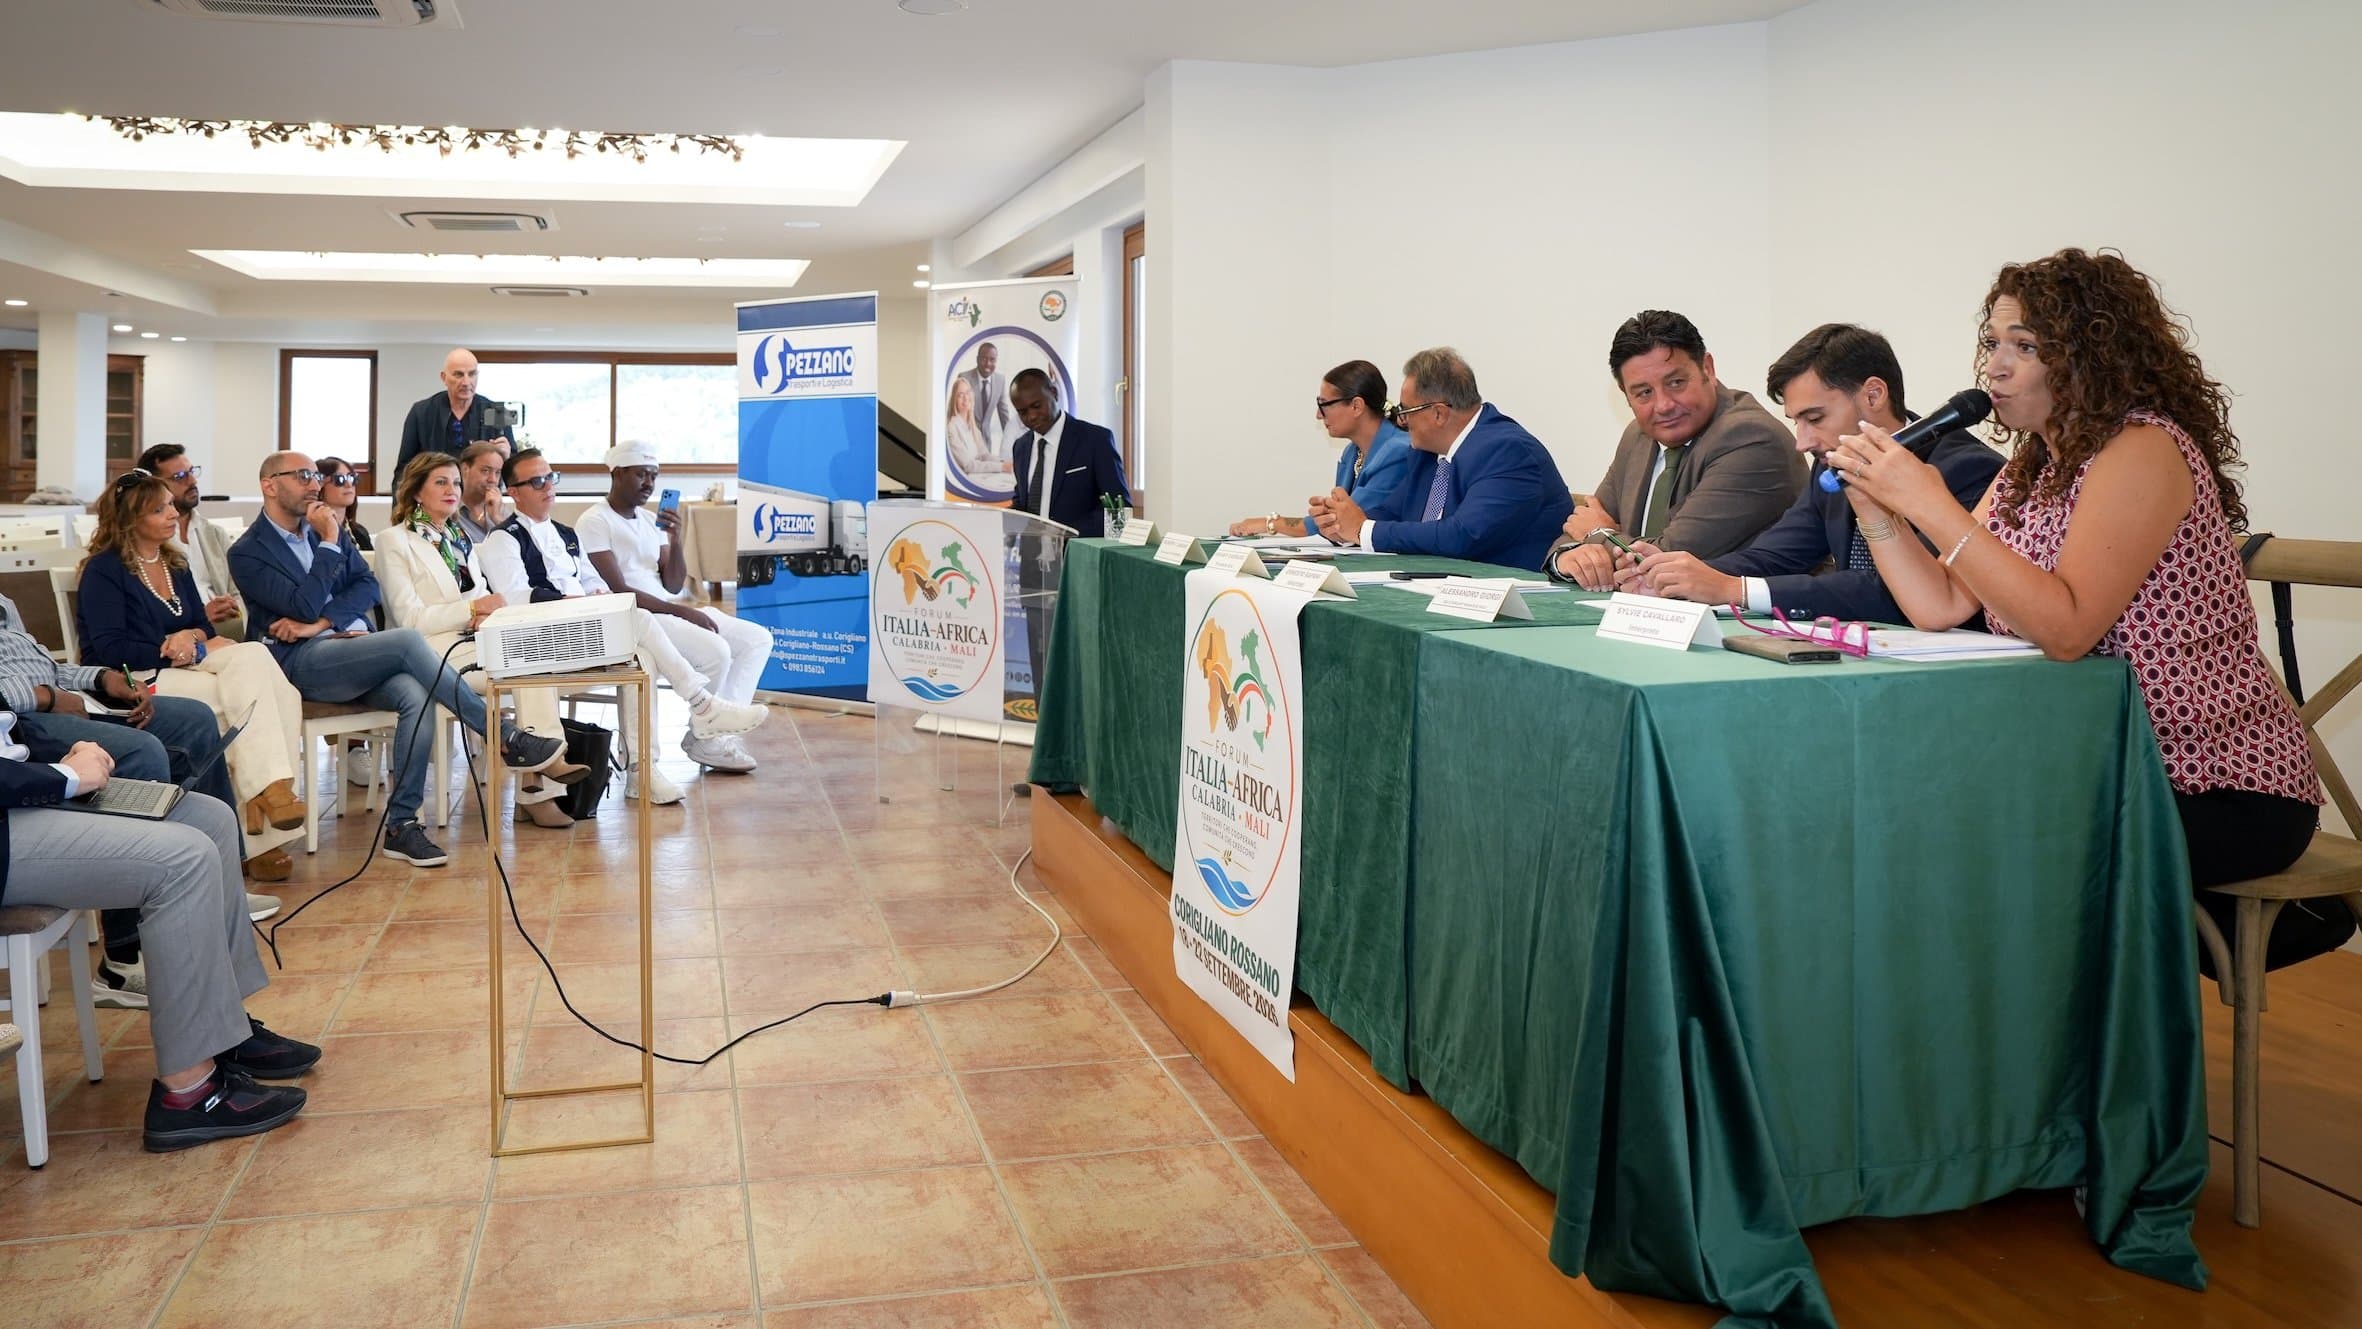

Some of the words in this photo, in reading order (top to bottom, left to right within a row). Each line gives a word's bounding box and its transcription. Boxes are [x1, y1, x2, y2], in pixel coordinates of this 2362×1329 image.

[753, 334, 855, 394] SPEZZANO
[822, 377, 853, 389] Logistica
[753, 503, 816, 543] SPEZZANO
[914, 608, 953, 619] FORUM
[1616, 606, 1641, 617] SYLVIE
[1642, 610, 1687, 624] CAVALLARO
[785, 627, 818, 638] Industriale
[834, 632, 867, 643] Corigliano
[883, 614, 989, 646] ITALIA-AFRICA
[779, 639, 839, 652] Corigliano-Rossano
[839, 643, 855, 655] (CS)
[892, 636, 941, 653] CALABRIA
[950, 643, 977, 657] MALI
[1215, 739, 1249, 768] FORUM
[1185, 745, 1284, 823] ITALIA-AFRICA
[1192, 784, 1236, 822] CALABRIA
[1245, 810, 1270, 840] MALI
[1174, 893, 1228, 956] CORIGLIANO
[1230, 935, 1280, 998] ROSSANO
[1193, 937, 1203, 963] 22
[1203, 947, 1253, 1009] SETTEMBRE
